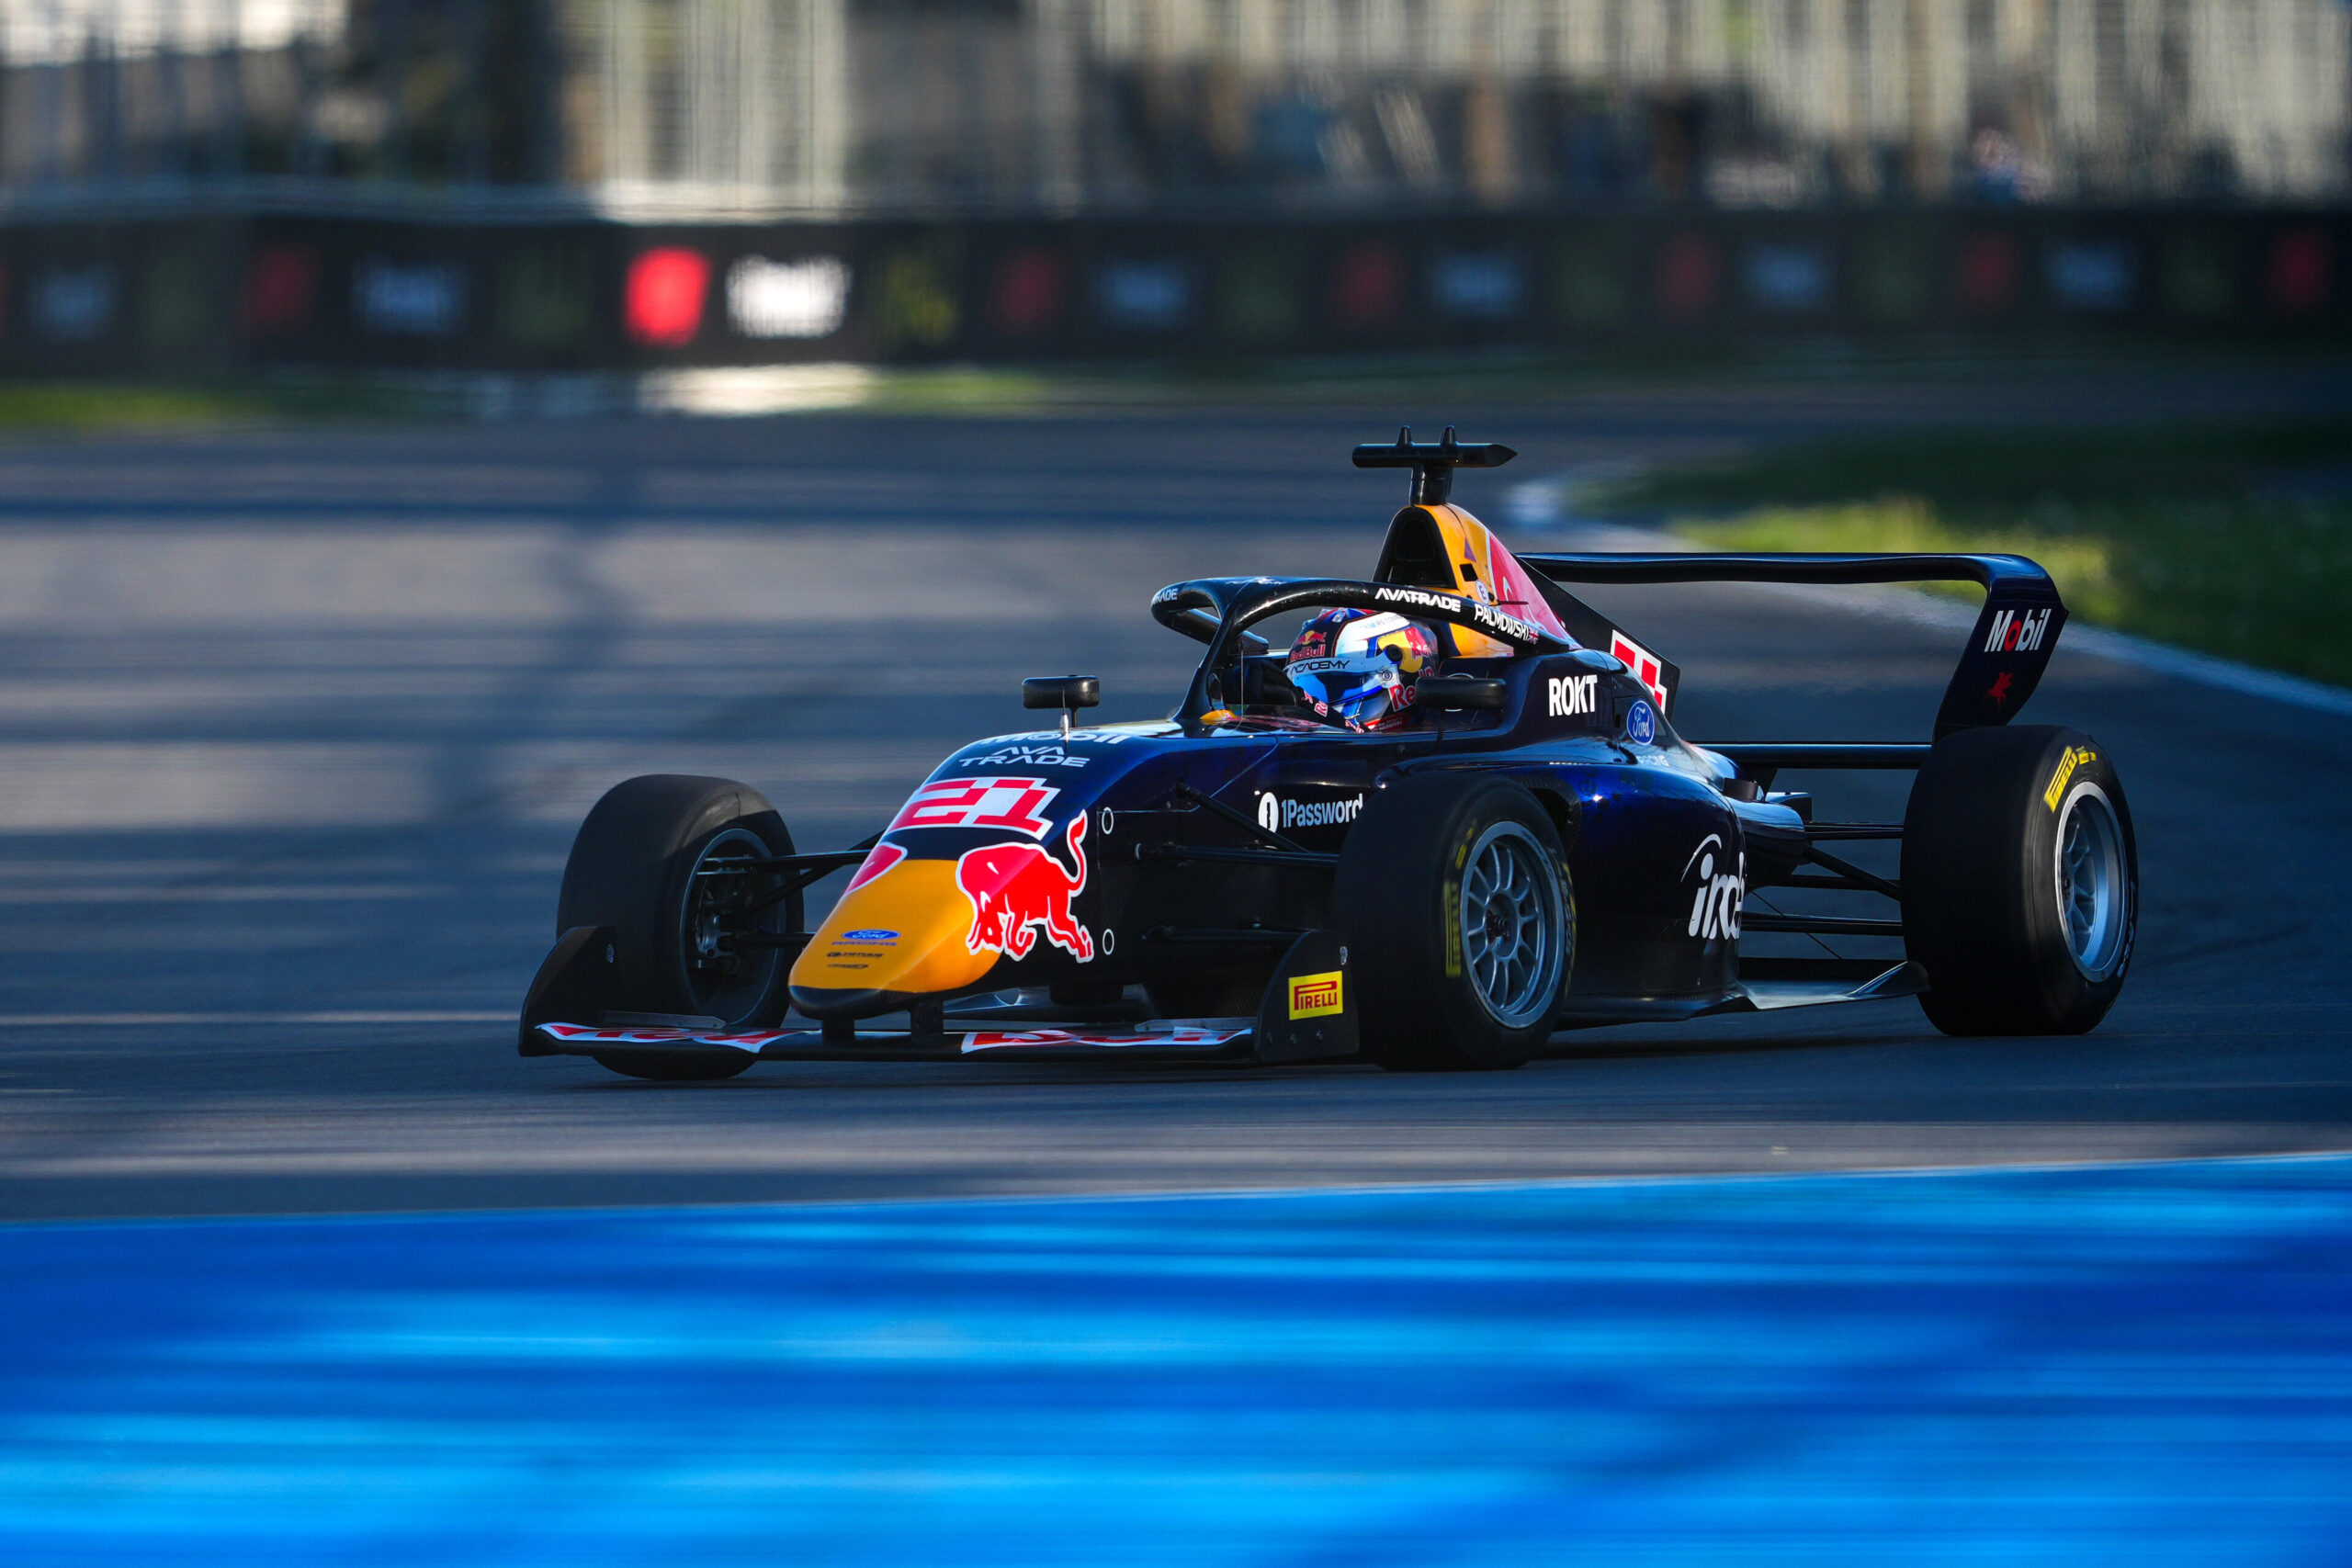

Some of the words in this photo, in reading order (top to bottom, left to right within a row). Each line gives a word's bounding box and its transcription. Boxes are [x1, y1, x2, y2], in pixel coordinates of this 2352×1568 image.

[1375, 588, 1461, 613] AVATRADE
[1475, 604, 1530, 641] PALMOWSKI
[1984, 608, 2052, 652] Mobil
[1290, 648, 1306, 662] Red
[1305, 644, 1326, 659] Bull
[1290, 660, 1351, 673] ACADEMY
[1389, 684, 1416, 712] Re
[1549, 675, 1598, 716] ROKT
[1632, 705, 1651, 739] Ford
[959, 755, 1091, 768] TRADE
[990, 746, 1065, 755] AVA
[885, 777, 1061, 840] 21
[1281, 793, 1363, 829] 1Password
[1294, 980, 1338, 1010] PIRELLI
